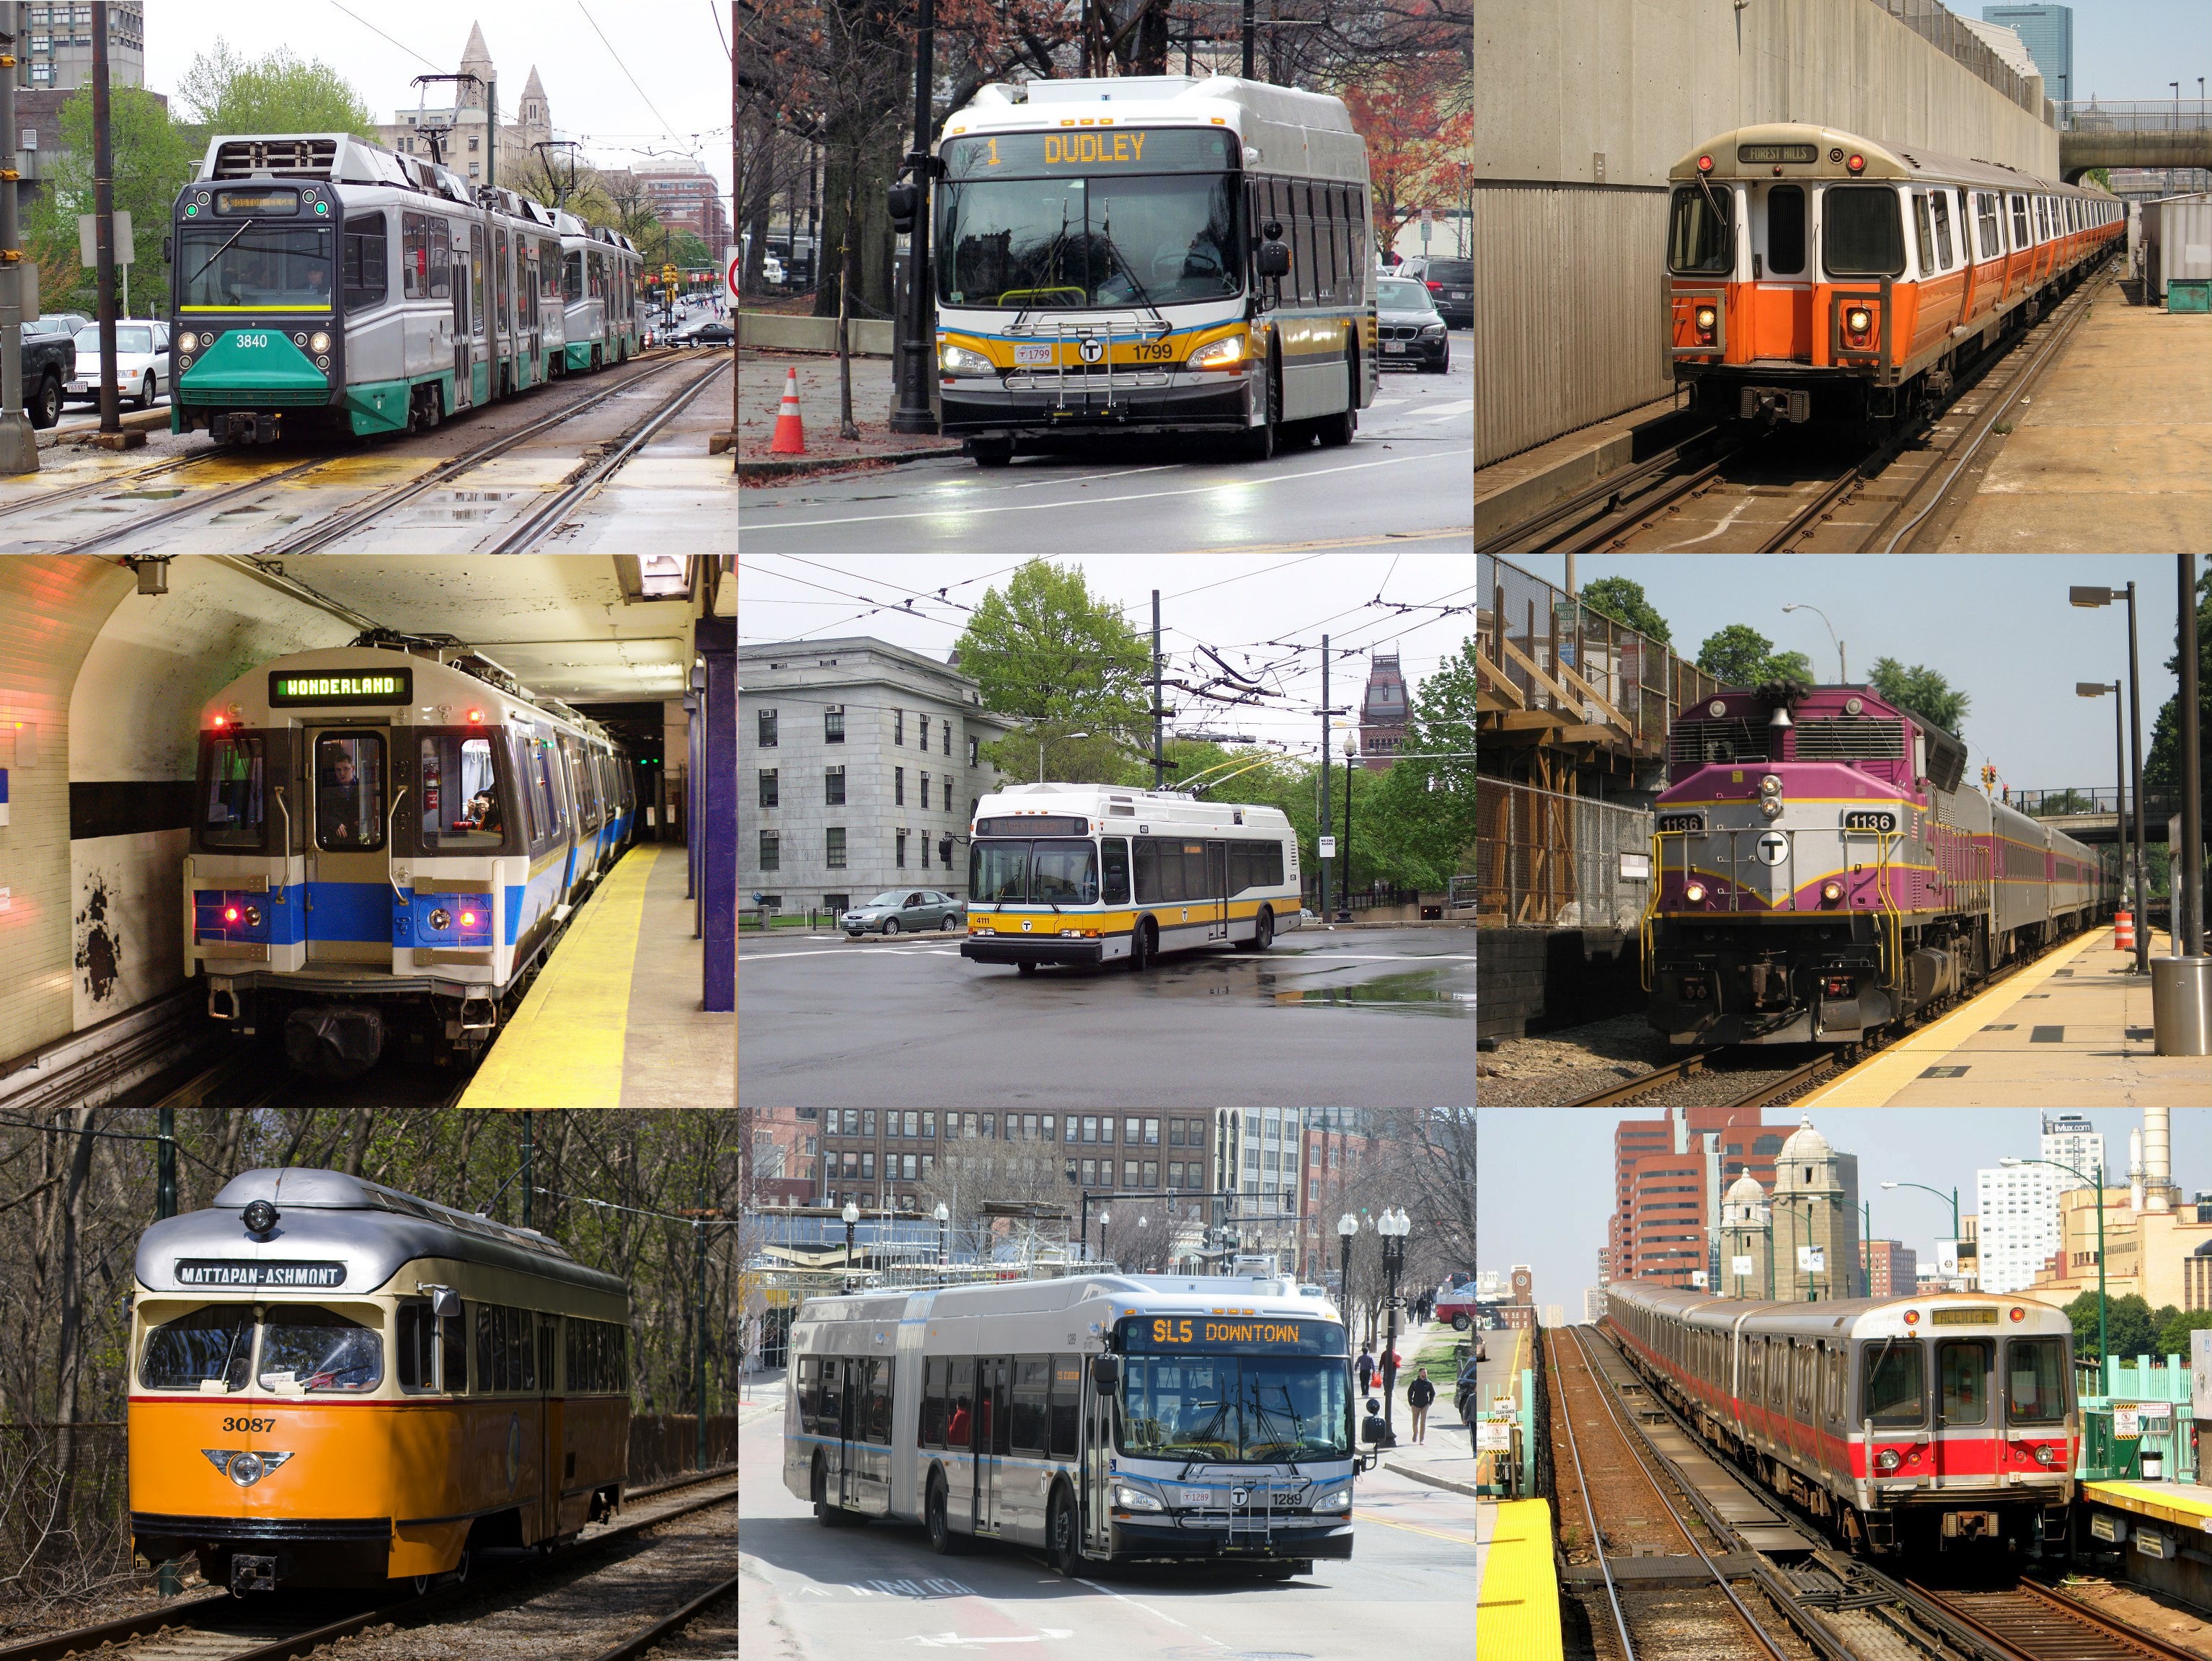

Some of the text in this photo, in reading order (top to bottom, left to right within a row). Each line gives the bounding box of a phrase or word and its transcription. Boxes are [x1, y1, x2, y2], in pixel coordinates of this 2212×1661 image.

[987, 132, 1145, 165] 1 DUDLEY
[1750, 146, 1807, 160] FOREST HILLS
[236, 335, 267, 347] 3840
[1029, 349, 1050, 359] 1799
[1085, 345, 1099, 360] T
[1133, 344, 1172, 360] 1799
[288, 678, 394, 695] WONDERLAND
[1664, 817, 1698, 830] 1136
[1852, 815, 1890, 829] 1136
[1761, 840, 1783, 860] T
[2054, 1122, 2090, 1133] livlux.com
[182, 1267, 337, 1284] MATTAPAN-ASHMONT
[1940, 1311, 1989, 1324] ALEWIFE
[1153, 1319, 1299, 1342] SL5 DOWNTOWN
[1067, 1333, 1076, 1345] 1289
[222, 1417, 276, 1433] 3087
[1192, 1493, 1209, 1502] 1289
[1233, 1492, 1245, 1503] T
[1272, 1492, 1302, 1505] 1289
